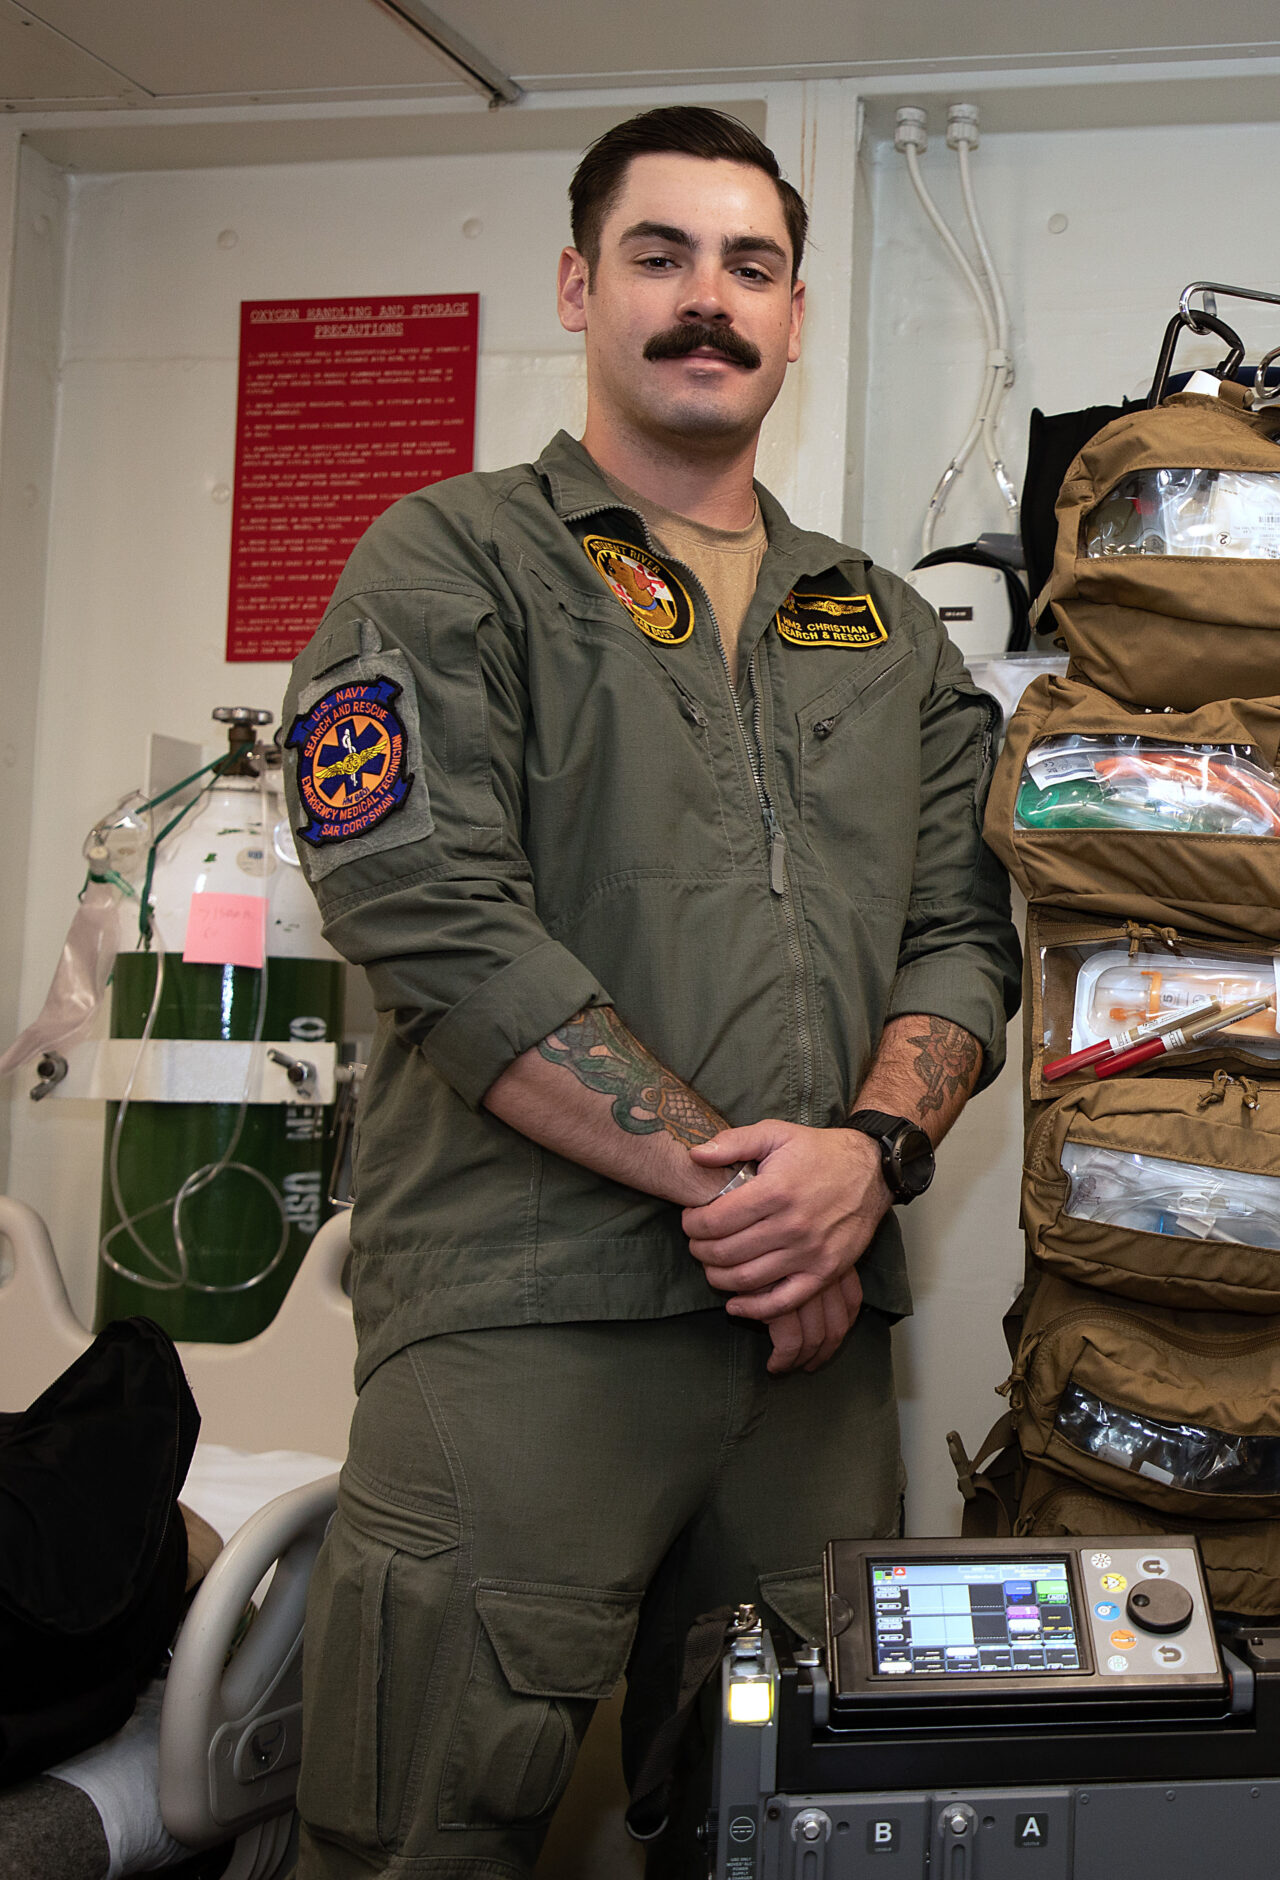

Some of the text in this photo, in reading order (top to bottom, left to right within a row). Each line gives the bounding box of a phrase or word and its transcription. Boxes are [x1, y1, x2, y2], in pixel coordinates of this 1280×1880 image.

[250, 302, 469, 322] OXYGEN HANDLING AND STORAGE
[314, 322, 404, 337] PRECAUTIONS
[630, 550, 661, 574] RIVER
[781, 623, 878, 642] SEARCH & RESCUE
[783, 616, 868, 634] HM2 CHRISTIAN
[312, 686, 368, 722] U.S. NAVY
[304, 701, 389, 758] SEARCH AND RESCUE
[301, 733, 403, 822] EMERGENCY MEDICAL TECHNICIAN
[321, 794, 396, 836] SAR CORPSMAN
[282, 1171, 322, 1234] USP
[874, 1816, 1041, 1843] B A
